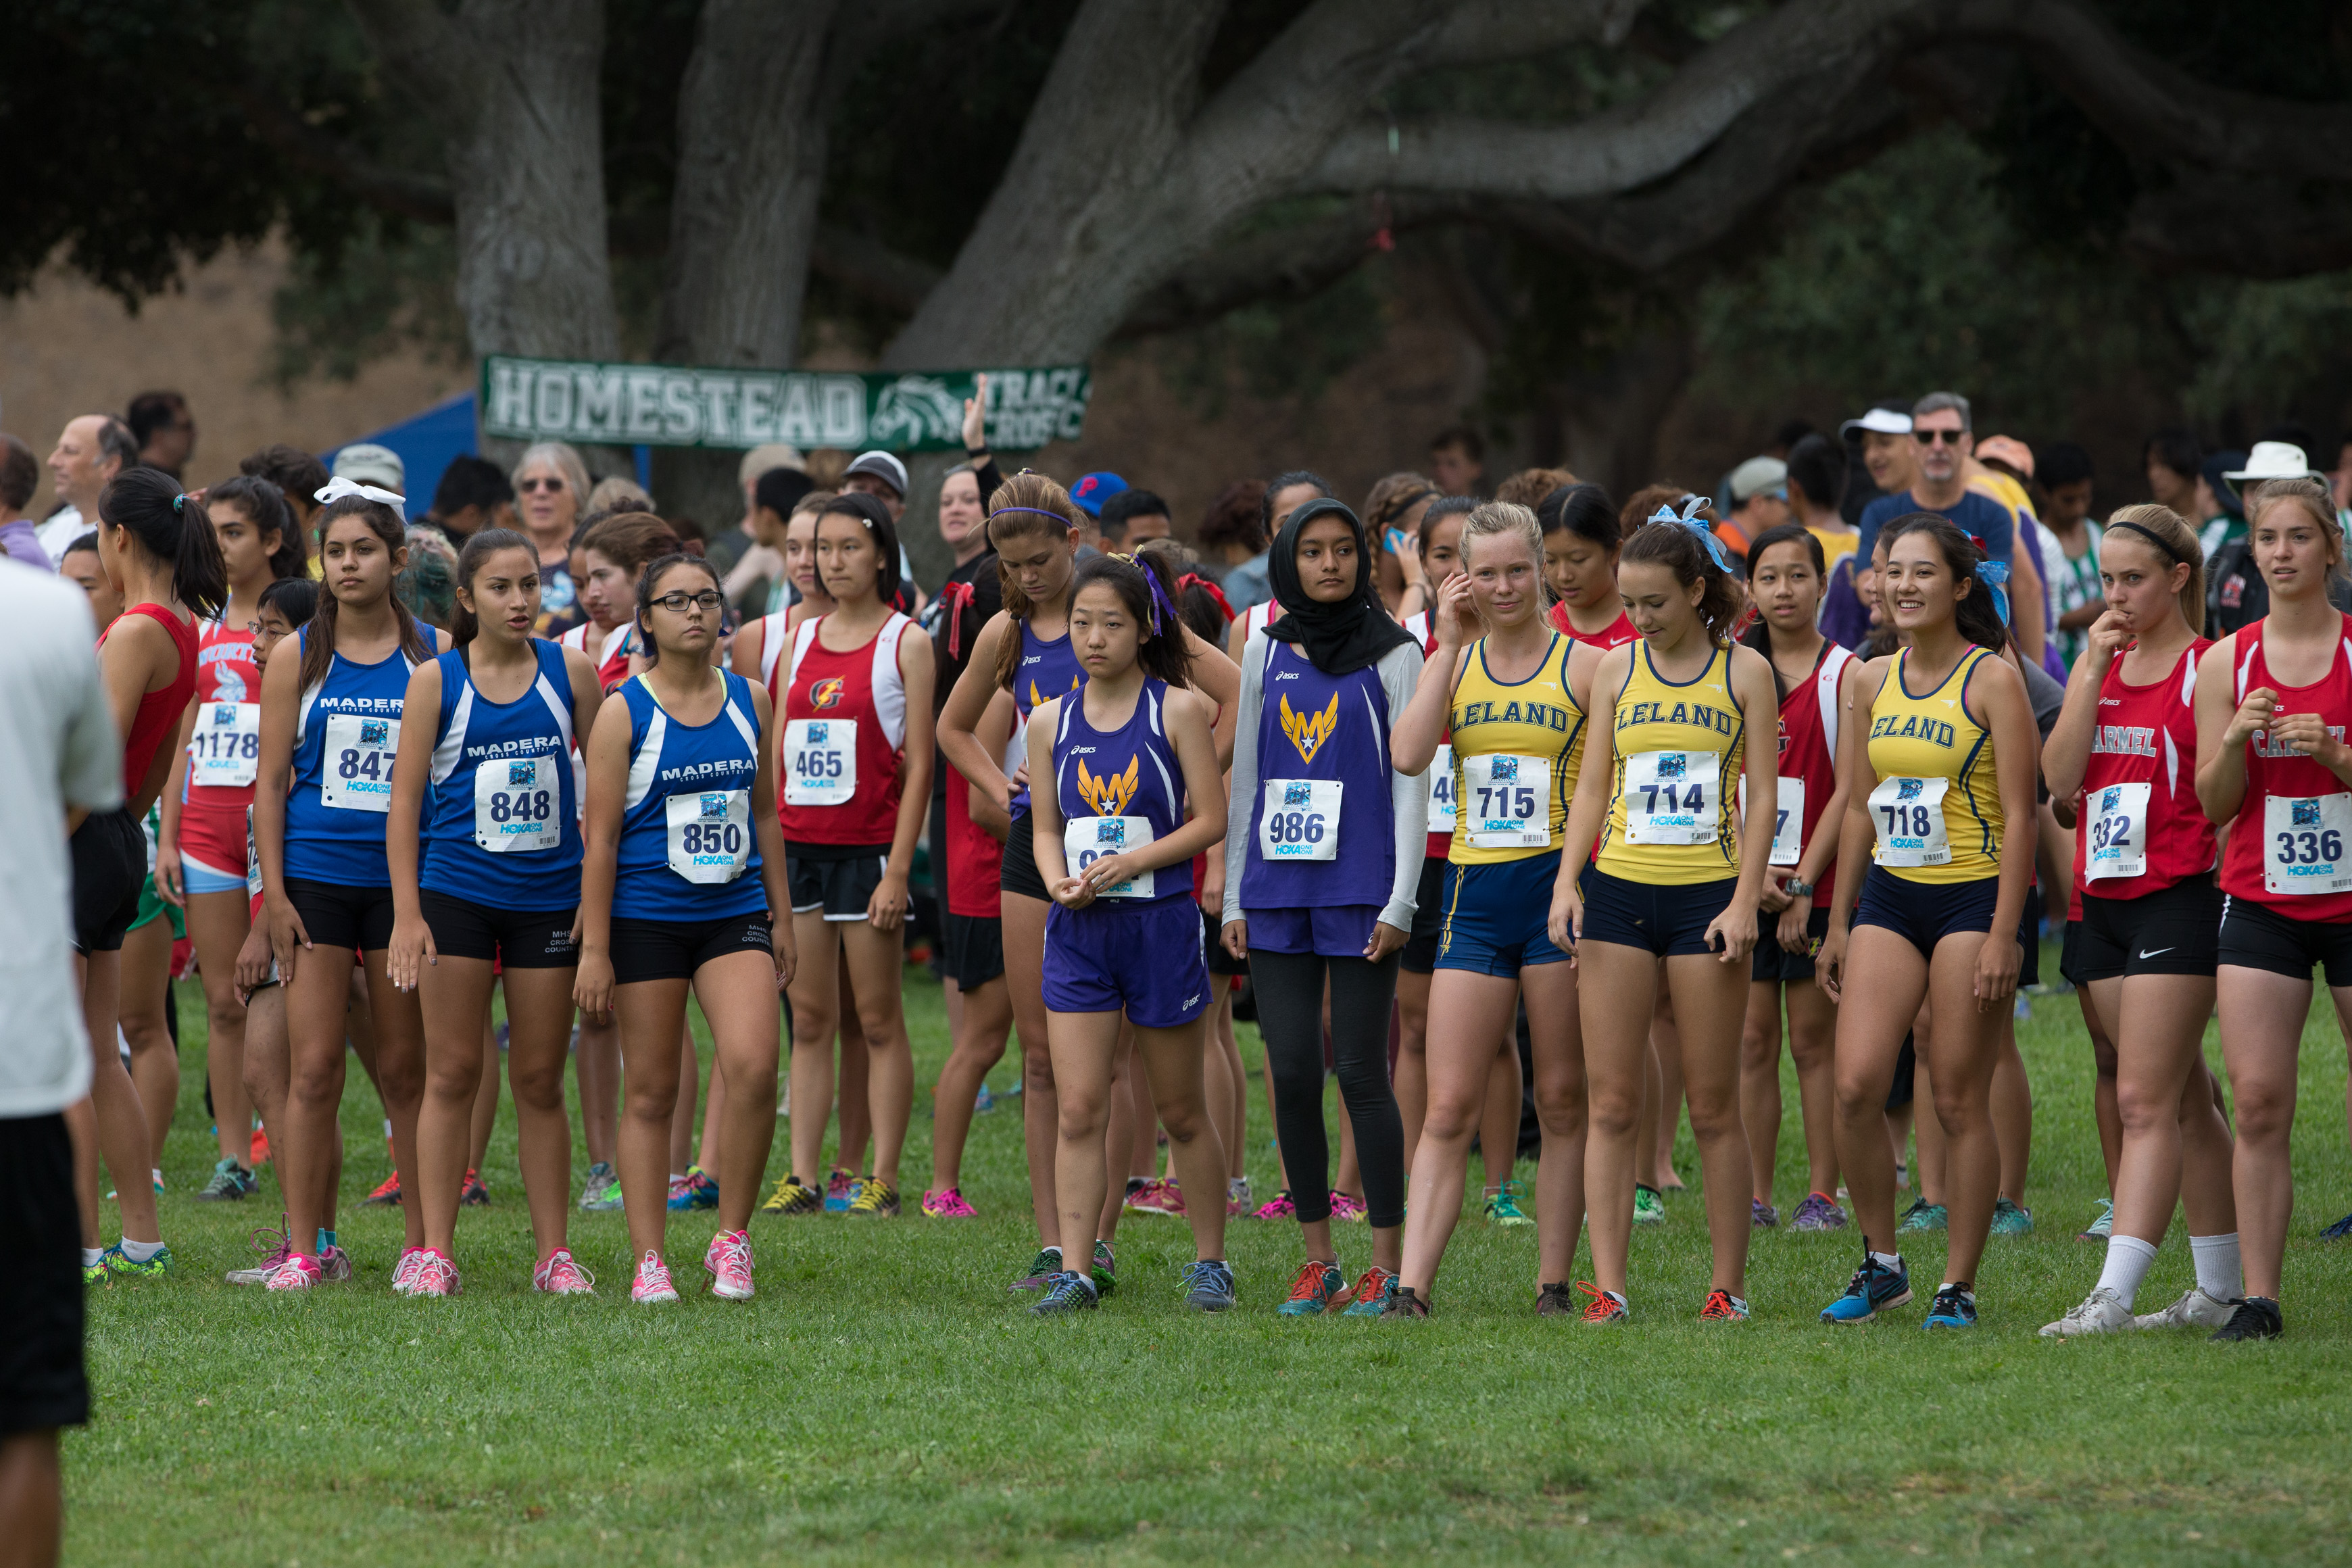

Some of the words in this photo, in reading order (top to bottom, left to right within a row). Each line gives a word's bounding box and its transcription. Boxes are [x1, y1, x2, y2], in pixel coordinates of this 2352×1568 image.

[488, 359, 867, 445] HOMESTEAD
[1076, 476, 1099, 497] P
[320, 697, 404, 708] MADER
[1452, 701, 1568, 735] LELAND
[1616, 702, 1732, 737] LELAND
[196, 732, 259, 759] 1178
[1870, 715, 1956, 749] ELAND
[2092, 725, 2157, 757] ARMEL
[467, 736, 561, 757] MADERA
[516, 747, 549, 756] COUNTRY
[339, 748, 397, 782] 847
[662, 759, 754, 781] MADERA
[681, 774, 704, 782] CROSS
[710, 769, 744, 777] COUNTRY
[796, 750, 841, 777] 465
[346, 781, 378, 793] HOKA
[1640, 783, 1704, 814] 714
[491, 790, 550, 823] 848
[1441, 806, 1456, 814] HO
[1477, 787, 1535, 818] 715
[500, 823, 531, 833] HOKA
[1270, 812, 1325, 843] 986
[1484, 820, 1512, 830] HOKA
[1649, 816, 1682, 826] HOKA
[1880, 805, 1931, 837] 718
[683, 823, 741, 854] 850
[1890, 837, 1913, 848] HOKA
[2093, 816, 2130, 854] 332
[2277, 829, 2343, 864] 336
[693, 855, 722, 865] HOKA
[1275, 845, 1301, 855] HOKA
[2287, 866, 2321, 876] HOKA
